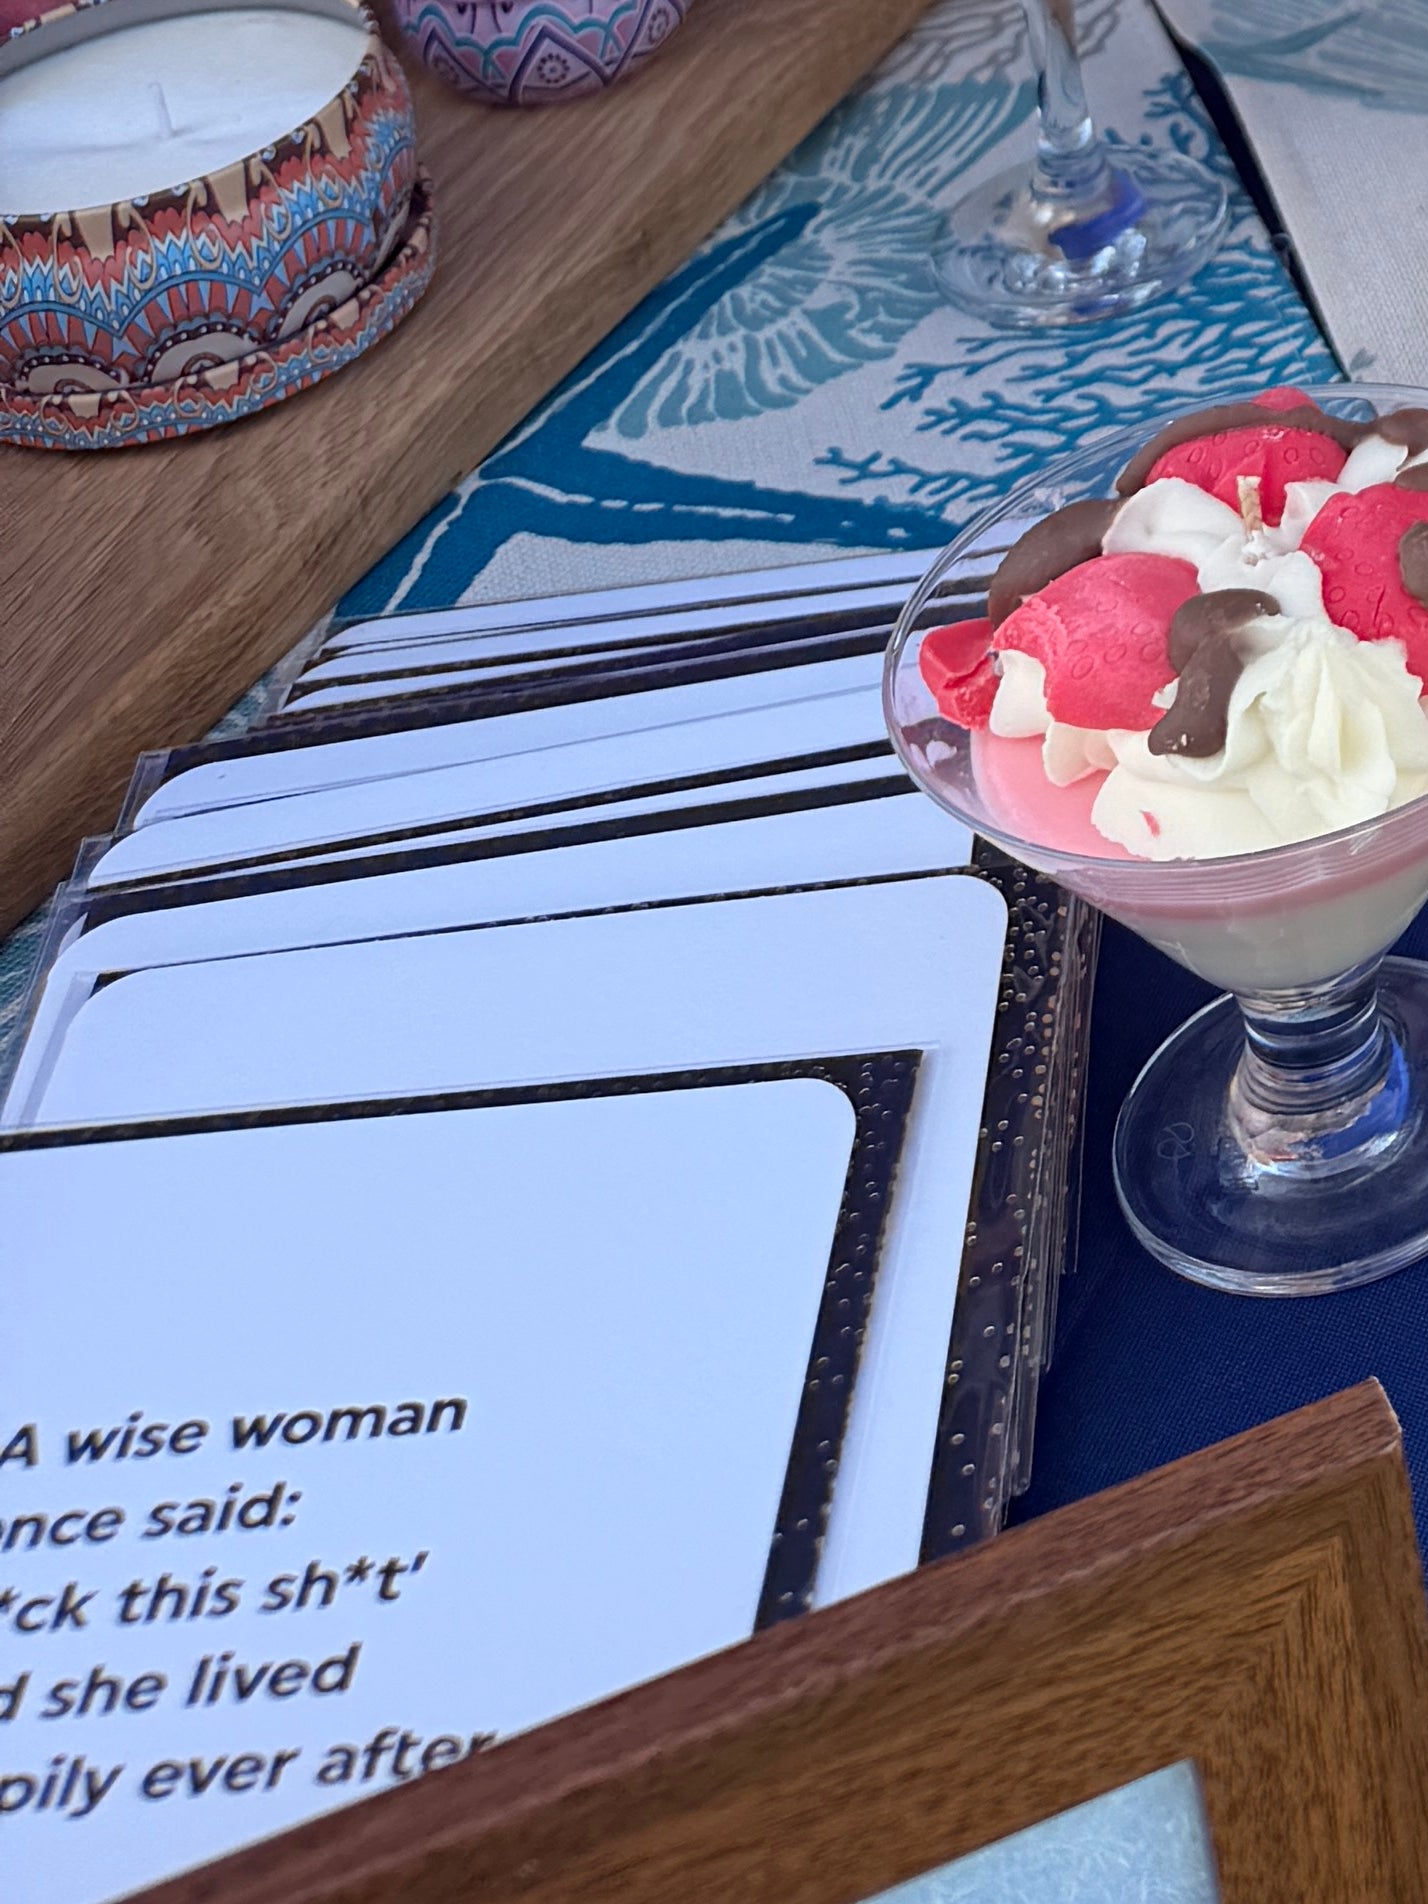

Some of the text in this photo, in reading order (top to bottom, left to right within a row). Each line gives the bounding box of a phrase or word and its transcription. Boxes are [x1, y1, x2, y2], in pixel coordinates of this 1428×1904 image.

[0, 1395, 469, 1469] A wise woman
[0, 1480, 303, 1551] nce said:
[115, 1565, 245, 1627] this
[38, 1662, 167, 1720] she
[183, 1640, 363, 1710] lived
[140, 1745, 303, 1801] ever
